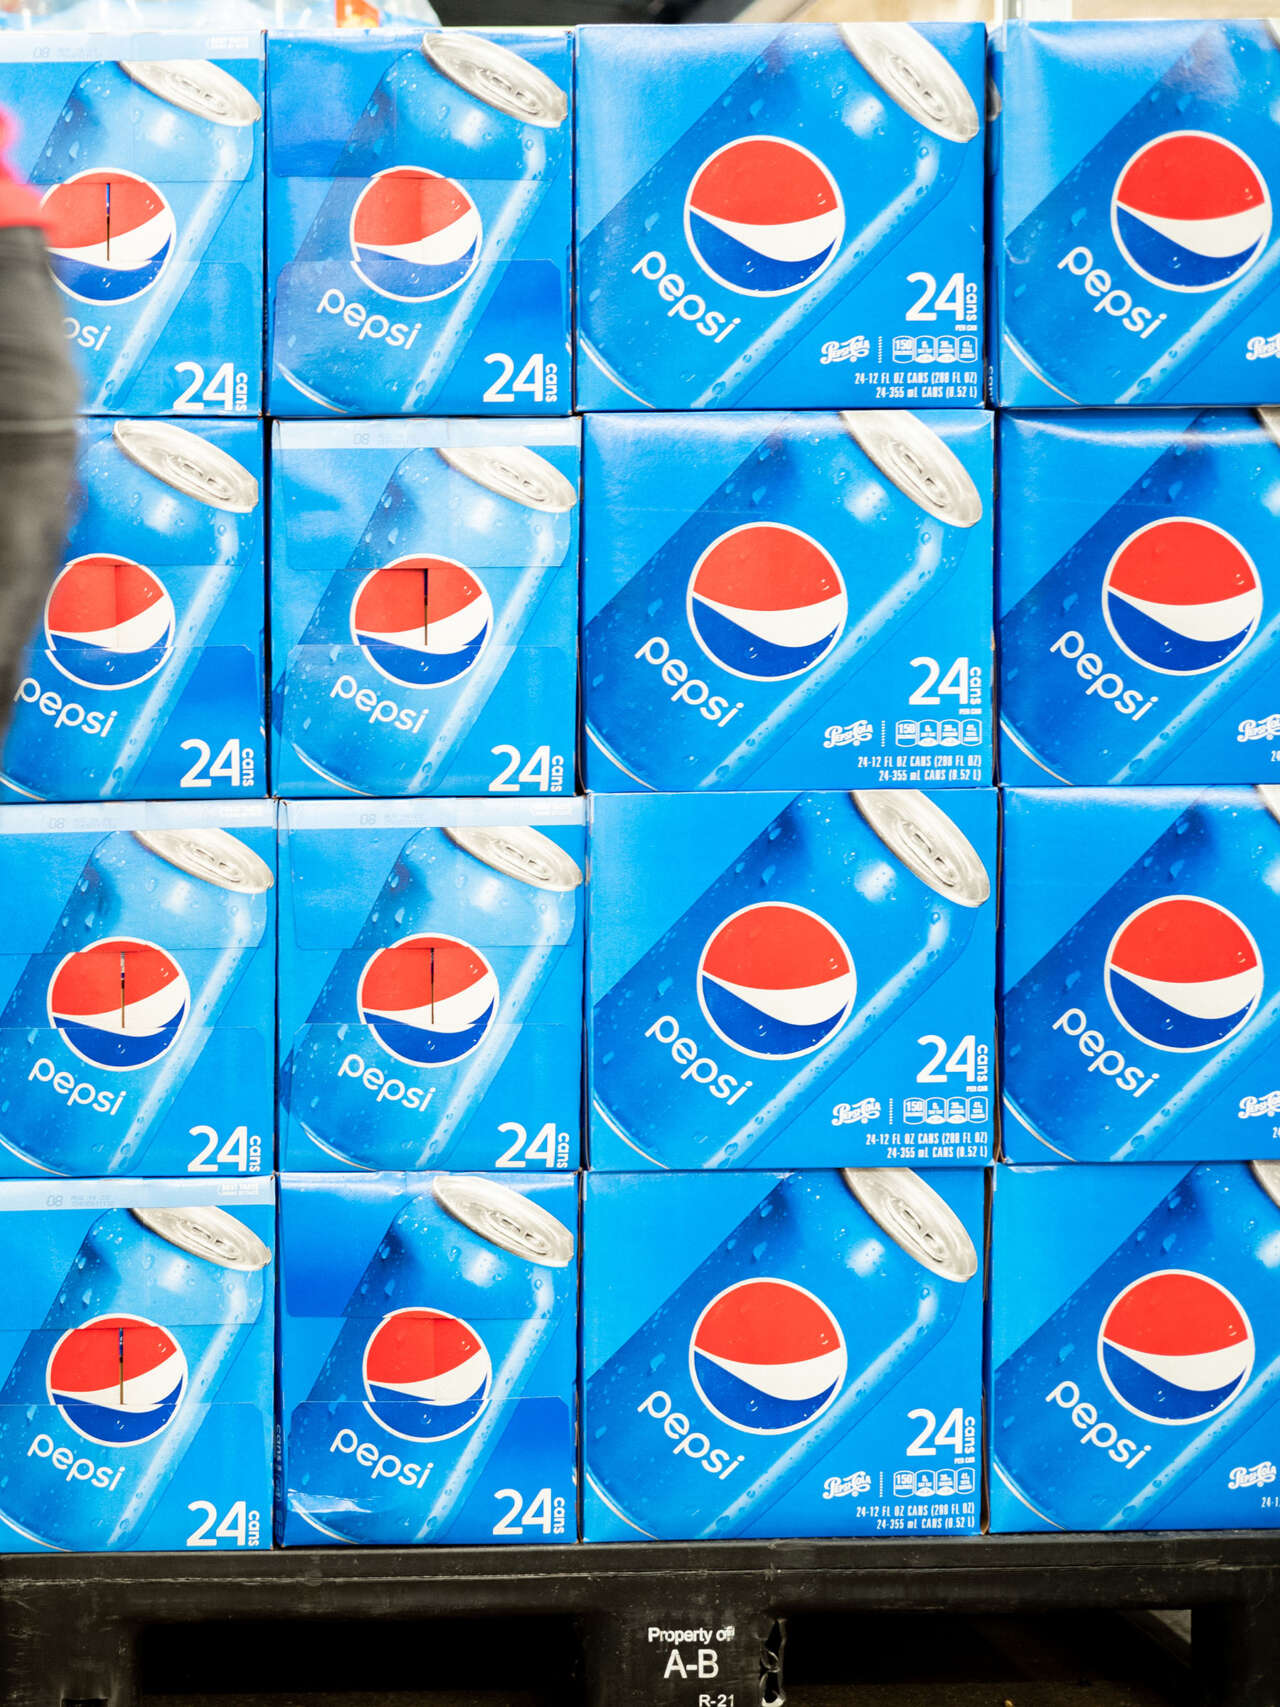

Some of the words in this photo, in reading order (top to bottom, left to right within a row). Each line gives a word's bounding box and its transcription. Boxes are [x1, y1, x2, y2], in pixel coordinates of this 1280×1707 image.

[632, 249, 743, 343] pepsi
[906, 272, 964, 321] 24
[966, 283, 977, 321] cans
[1058, 245, 1168, 339] pepsi
[315, 288, 422, 350] pepsi
[173, 361, 235, 411] 24
[235, 372, 248, 415] cans
[483, 353, 544, 402] 24
[545, 363, 557, 404] cans
[635, 636, 745, 727] pepsi
[909, 657, 968, 705] 24
[970, 667, 981, 705] cans
[1050, 630, 1159, 720] pepsi
[14, 676, 118, 737] pepsi
[329, 674, 430, 734] pepsi
[180, 739, 240, 787] 24
[241, 748, 254, 788] cans
[489, 745, 549, 794] 24
[550, 754, 563, 792] cans
[645, 1015, 753, 1105] pepsi
[917, 1035, 976, 1083] 24
[977, 1044, 988, 1082] cans
[1053, 1008, 1160, 1097] pepsi
[28, 1055, 127, 1115] pepsi
[338, 1052, 437, 1112] pepsi
[188, 1125, 248, 1172] 24
[249, 1134, 261, 1174] cans
[496, 1122, 556, 1168] 24
[557, 1131, 569, 1168] cans
[918, 1133, 939, 1144] CANS
[933, 1147, 953, 1157] CANS
[638, 1390, 746, 1479] pepsi
[907, 1408, 963, 1456] 24
[965, 1417, 975, 1454] cans
[1046, 1380, 1152, 1469] pepsi
[28, 1432, 126, 1491] pepsi
[330, 1426, 435, 1488] pepsi
[187, 1500, 247, 1546] 24
[248, 1509, 261, 1550] cans
[493, 1488, 551, 1535] 24
[552, 1497, 565, 1536] cans
[908, 1505, 928, 1516] CANS
[922, 1515, 942, 1528] CANS
[648, 1627, 713, 1645] Property
[664, 1649, 718, 1678] A-B
[699, 1694, 733, 1707] R-21
